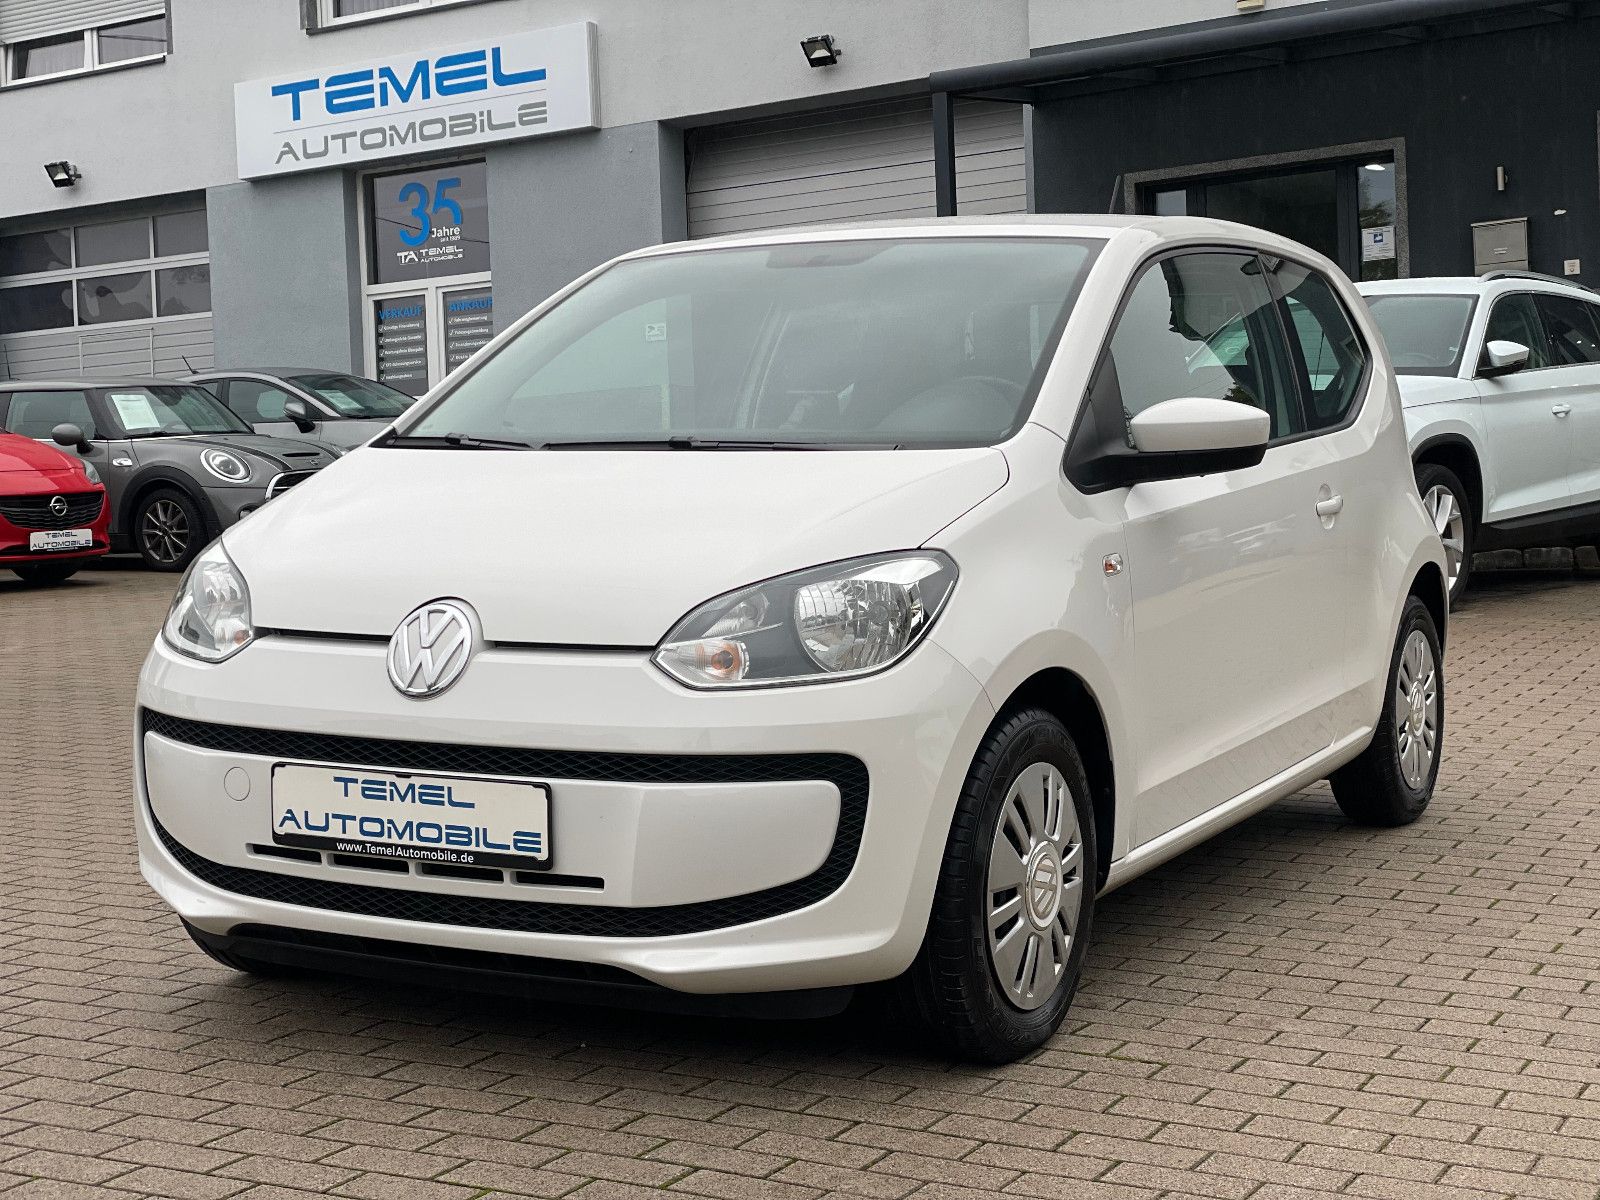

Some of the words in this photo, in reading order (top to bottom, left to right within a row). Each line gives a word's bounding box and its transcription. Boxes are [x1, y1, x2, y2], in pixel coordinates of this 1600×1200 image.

[271, 46, 547, 121] TEMEL
[399, 177, 463, 247] 35
[431, 226, 461, 238] Jahre
[397, 250, 419, 264] TA
[420, 245, 464, 257] TEMEL
[379, 306, 422, 319] VERKAUF
[449, 297, 493, 311] ANKAUF
[387, 602, 472, 697] VW
[333, 776, 475, 809] TEMEL
[279, 808, 542, 854] AUTOMOBILE
[336, 840, 474, 864] www.TemelAutomobile.de
